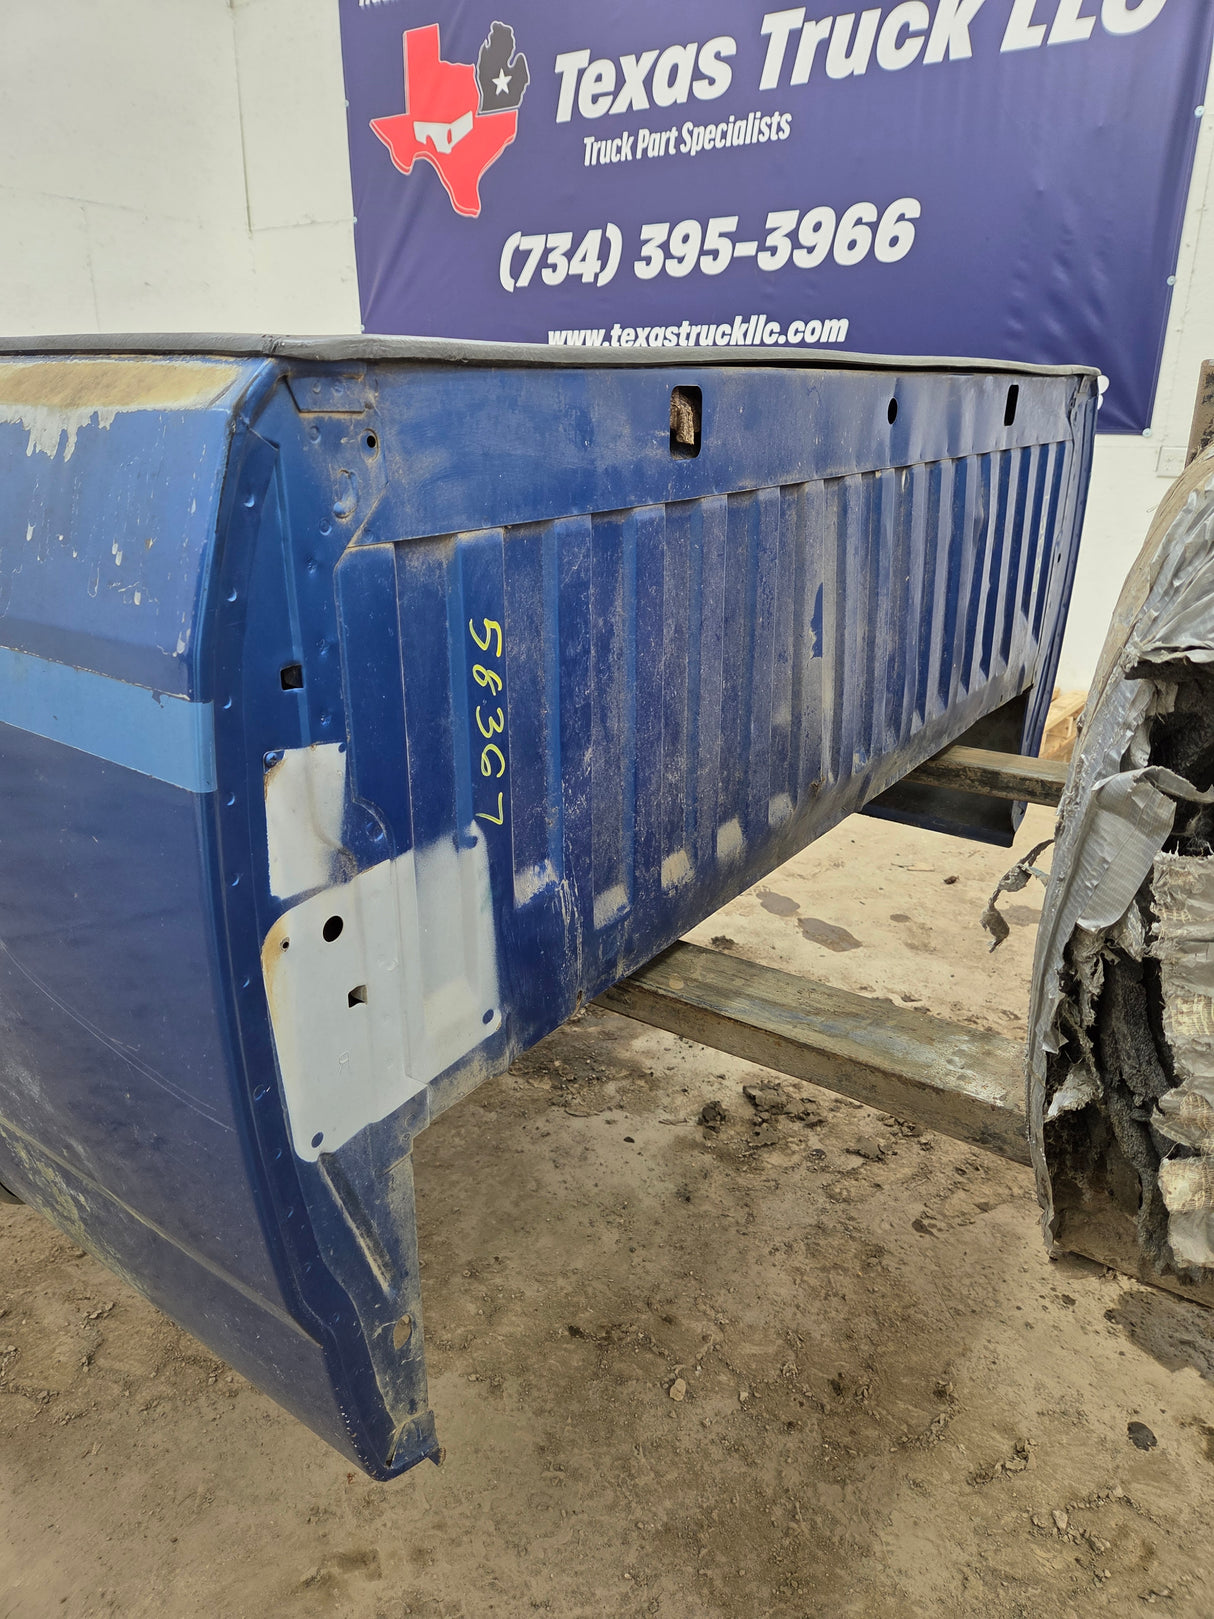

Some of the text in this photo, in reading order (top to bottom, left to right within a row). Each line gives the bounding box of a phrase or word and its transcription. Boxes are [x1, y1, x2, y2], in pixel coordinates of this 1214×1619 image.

[554, 37, 736, 123] Texas
[758, 0, 985, 91] Truck
[583, 112, 791, 167] Truck Part Specialists
[500, 198, 921, 292] (734) 395-3966
[548, 314, 849, 347] www.texastruckllc.com
